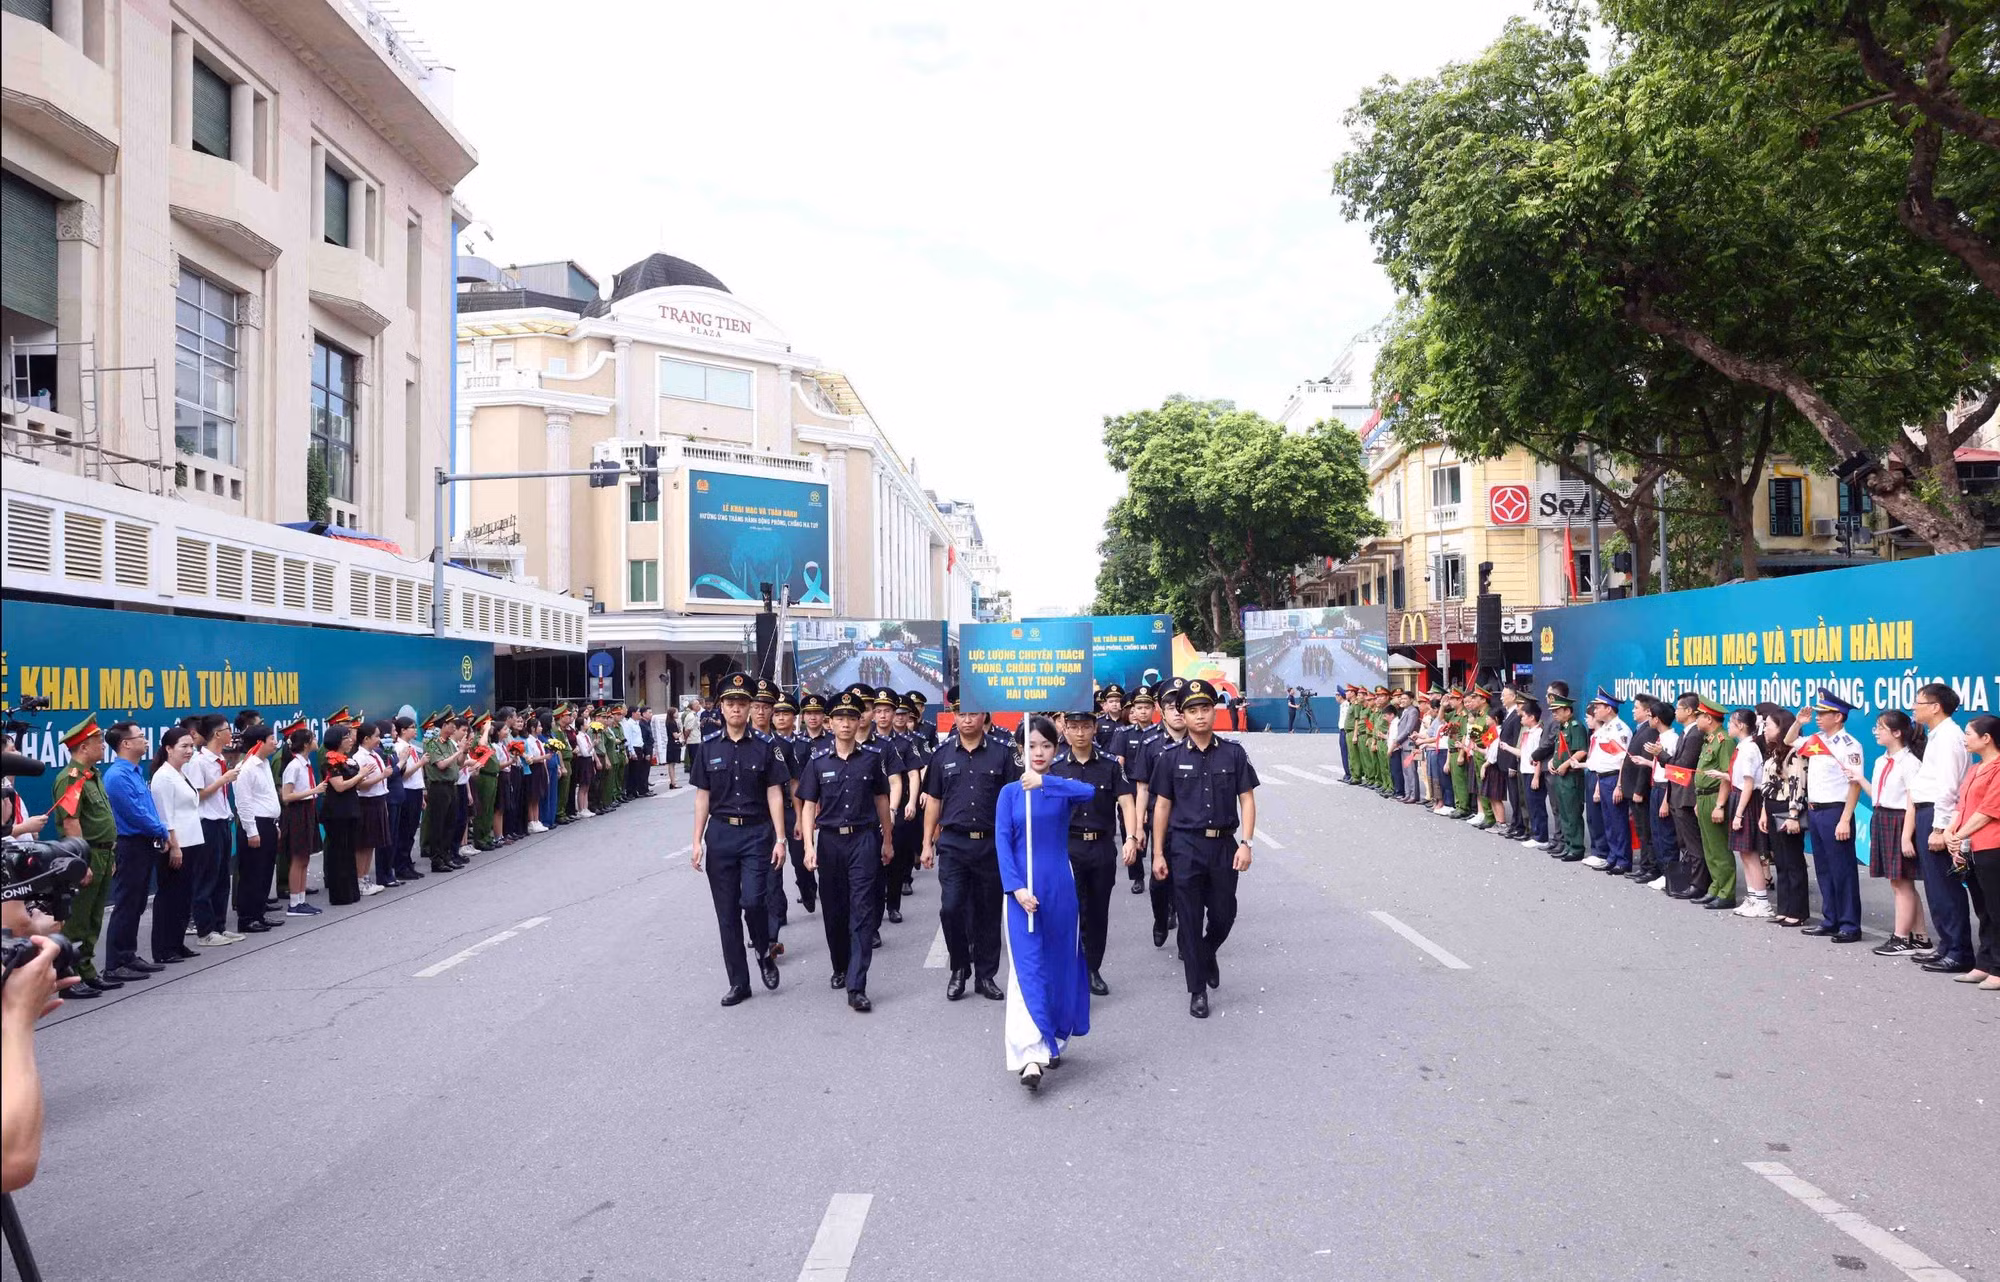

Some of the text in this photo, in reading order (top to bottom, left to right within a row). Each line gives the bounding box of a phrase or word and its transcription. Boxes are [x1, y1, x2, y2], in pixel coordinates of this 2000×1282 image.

[658, 305, 752, 334] TRANG TIEN
[691, 326, 722, 338] PLAZA
[1666, 615, 1913, 671] LỄ KHAI MẠC VÀ TUẦN HÀNH
[20, 666, 90, 711] KHAI
[99, 668, 154, 717] MẠC
[161, 664, 191, 708] VÀ
[196, 658, 248, 708] TUẦN
[253, 666, 299, 706] HÀNH
[1000, 676, 1014, 686] MA
[1023, 689, 1047, 700] QUAN
[1615, 671, 1650, 702] HƯỞNG
[1652, 673, 1675, 703] ỨNG
[1677, 672, 1717, 704] THÁNG
[1720, 672, 1757, 706] HÀNH
[1805, 670, 1870, 716] PHÒNG,
[1952, 676, 1989, 712] MA
